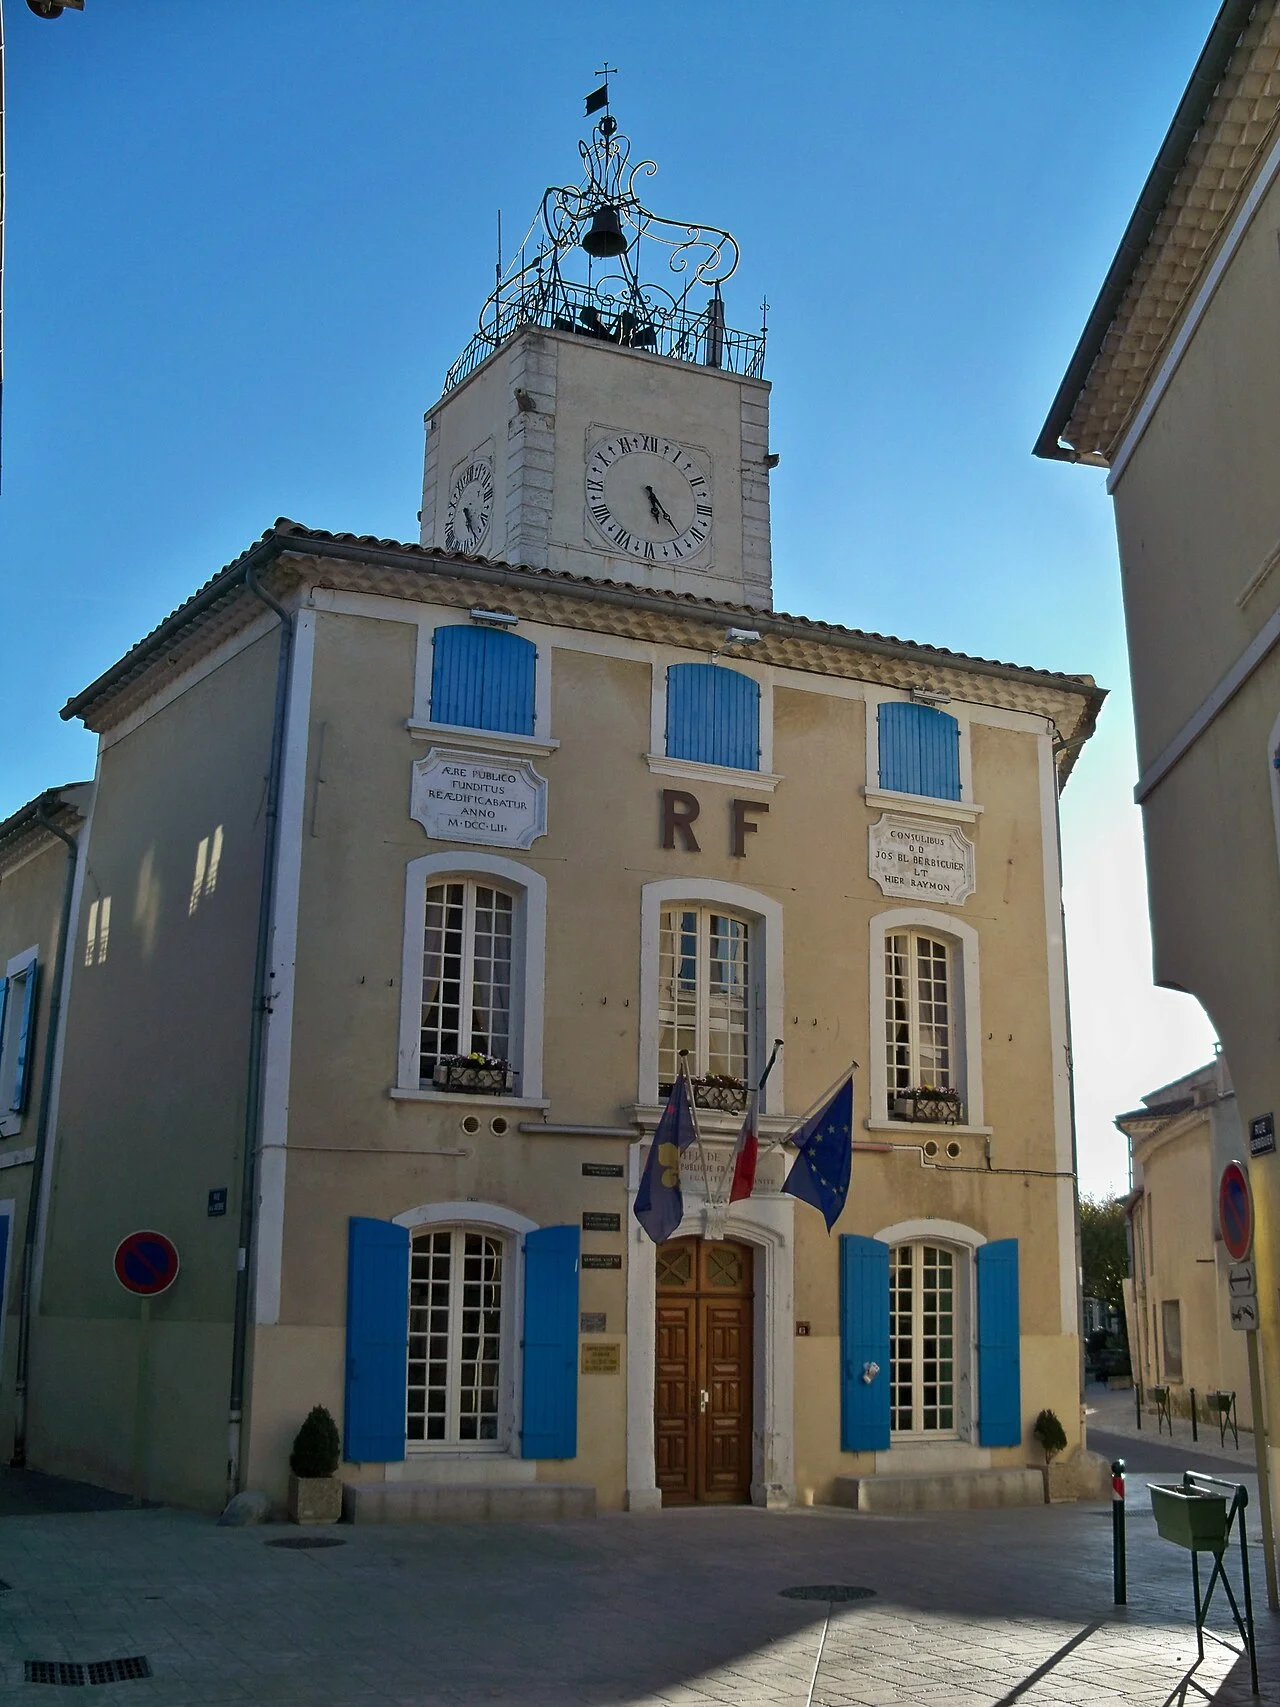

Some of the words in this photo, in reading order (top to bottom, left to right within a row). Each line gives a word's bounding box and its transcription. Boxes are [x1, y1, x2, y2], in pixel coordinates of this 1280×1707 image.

[616, 437, 632, 454] XI
[642, 435, 658, 453] XII
[595, 452, 611, 467] X
[673, 451, 682, 463] I
[587, 479, 603, 491] IX
[690, 476, 705, 487] II
[592, 504, 611, 525] VIII
[697, 504, 713, 517] III
[614, 529, 631, 550] VII
[690, 527, 705, 544] IV
[644, 542, 655, 559] VI
[673, 542, 683, 558] V
[473, 770, 517, 783] PUBLICO
[452, 781, 505, 795] FUNDITUS
[461, 808, 496, 819] ANNO
[663, 789, 701, 852] R
[733, 799, 770, 858] F
[890, 831, 945, 846] CONSULIBUS
[876, 851, 893, 860] JOS
[898, 854, 909, 863] BL
[885, 875, 904, 885] HIER
[911, 880, 950, 891] RAYMON
